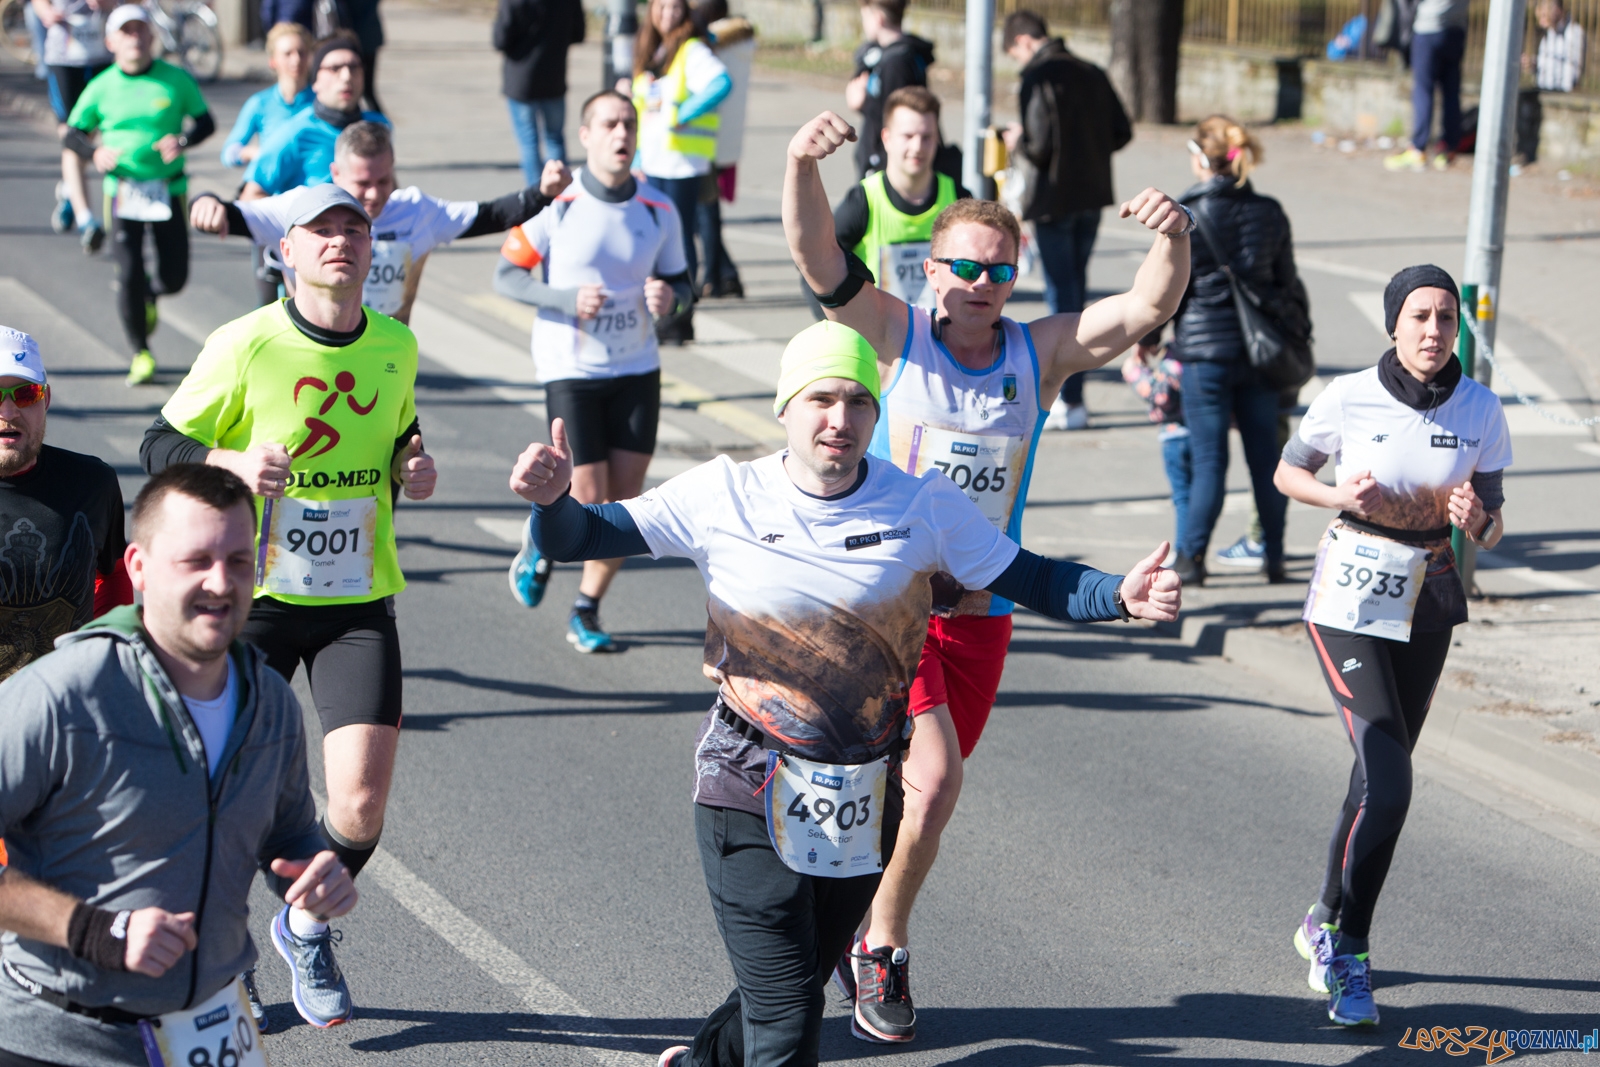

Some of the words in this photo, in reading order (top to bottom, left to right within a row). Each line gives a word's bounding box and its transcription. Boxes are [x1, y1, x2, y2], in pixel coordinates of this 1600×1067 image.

[369, 263, 406, 284] 304
[896, 262, 928, 282] 913
[1442, 438, 1456, 446] PKO
[963, 445, 977, 454] PKO
[934, 460, 1007, 493] 7065
[314, 512, 328, 520] PKO
[286, 527, 360, 556] 9001
[760, 533, 785, 543] 4F
[849, 538, 860, 546] 10.
[860, 534, 878, 544] PKO
[310, 559, 336, 567] Tomek
[1336, 562, 1408, 599] 3933
[813, 774, 825, 784] 10.
[825, 777, 841, 787] PKO
[787, 792, 871, 831] 4903
[807, 828, 853, 844] Sebastian
